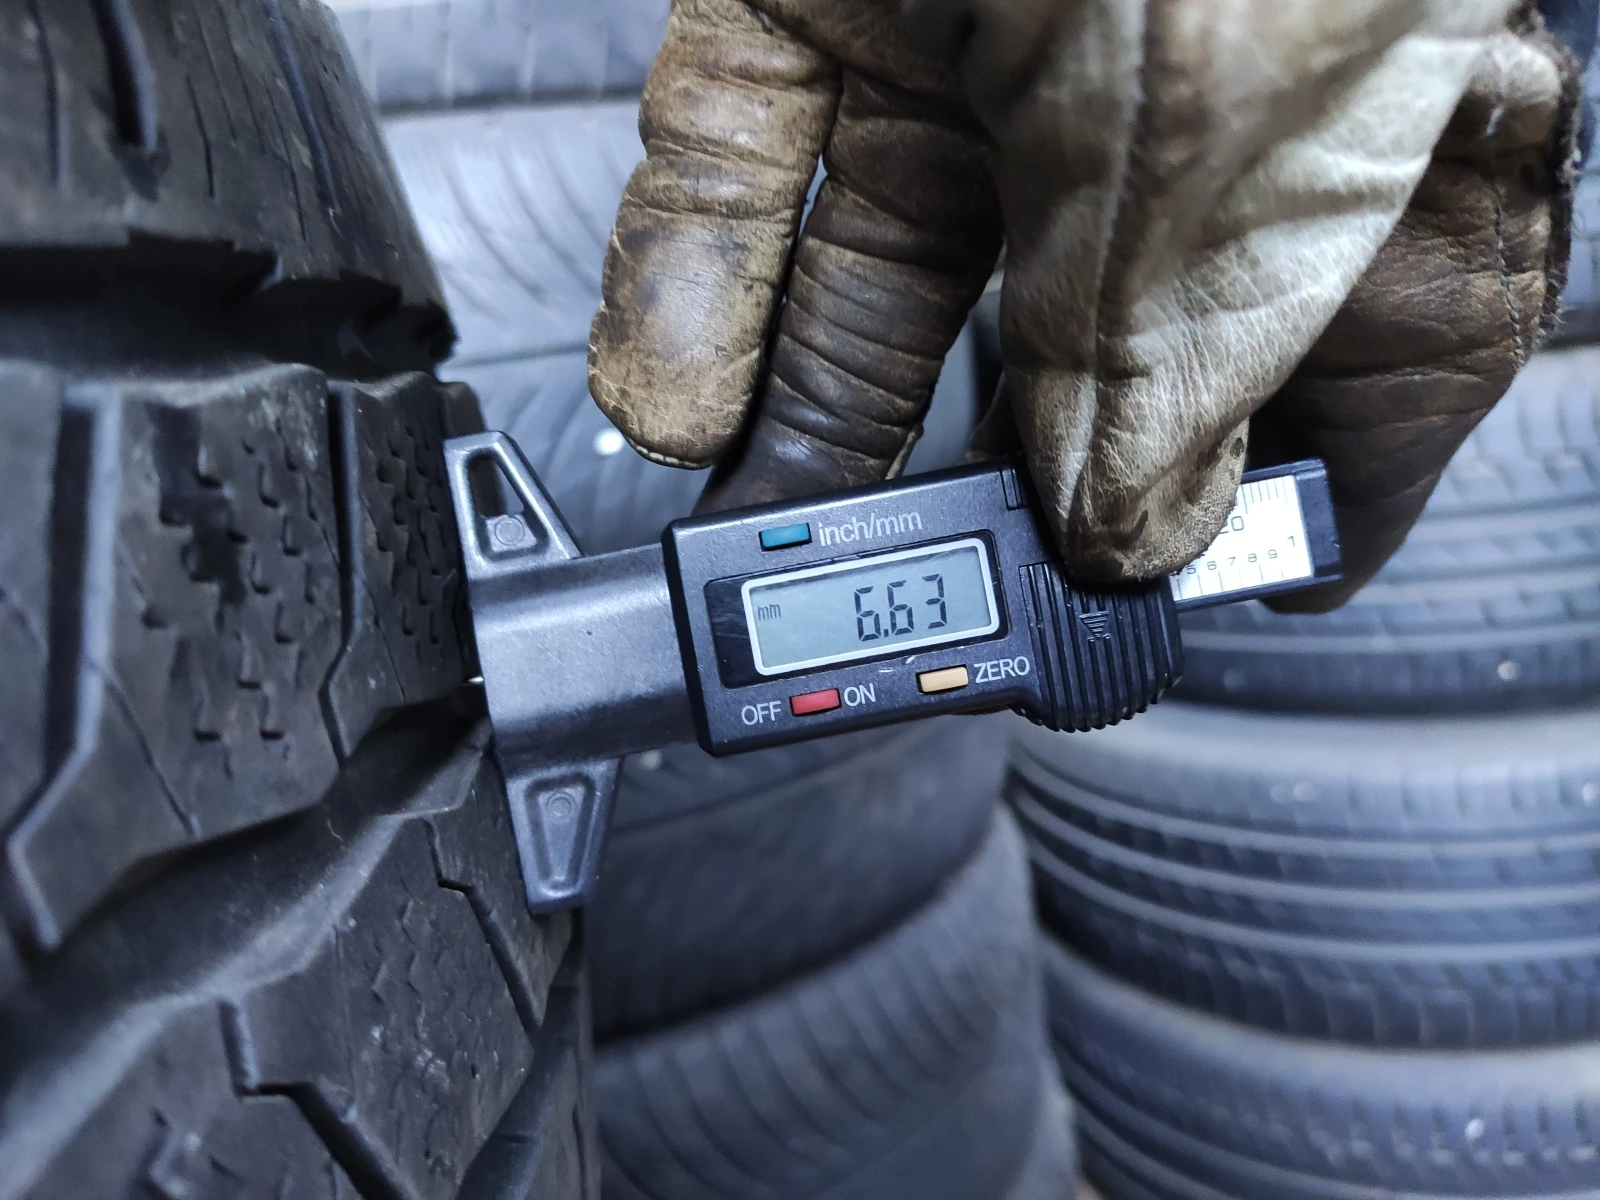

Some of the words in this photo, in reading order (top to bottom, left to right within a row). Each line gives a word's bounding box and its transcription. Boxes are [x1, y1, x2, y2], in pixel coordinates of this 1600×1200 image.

[818, 511, 923, 547] inch/mm
[1207, 561, 1217, 570] 6
[1227, 556, 1237, 566] 7
[1248, 553, 1257, 562] 8
[1268, 550, 1277, 559] 9
[1287, 536, 1295, 547] 1
[757, 603, 782, 621] mm
[853, 573, 948, 642] 6.63
[973, 656, 1030, 683] ZERO
[741, 700, 782, 726] OFF
[843, 684, 876, 707] ON
